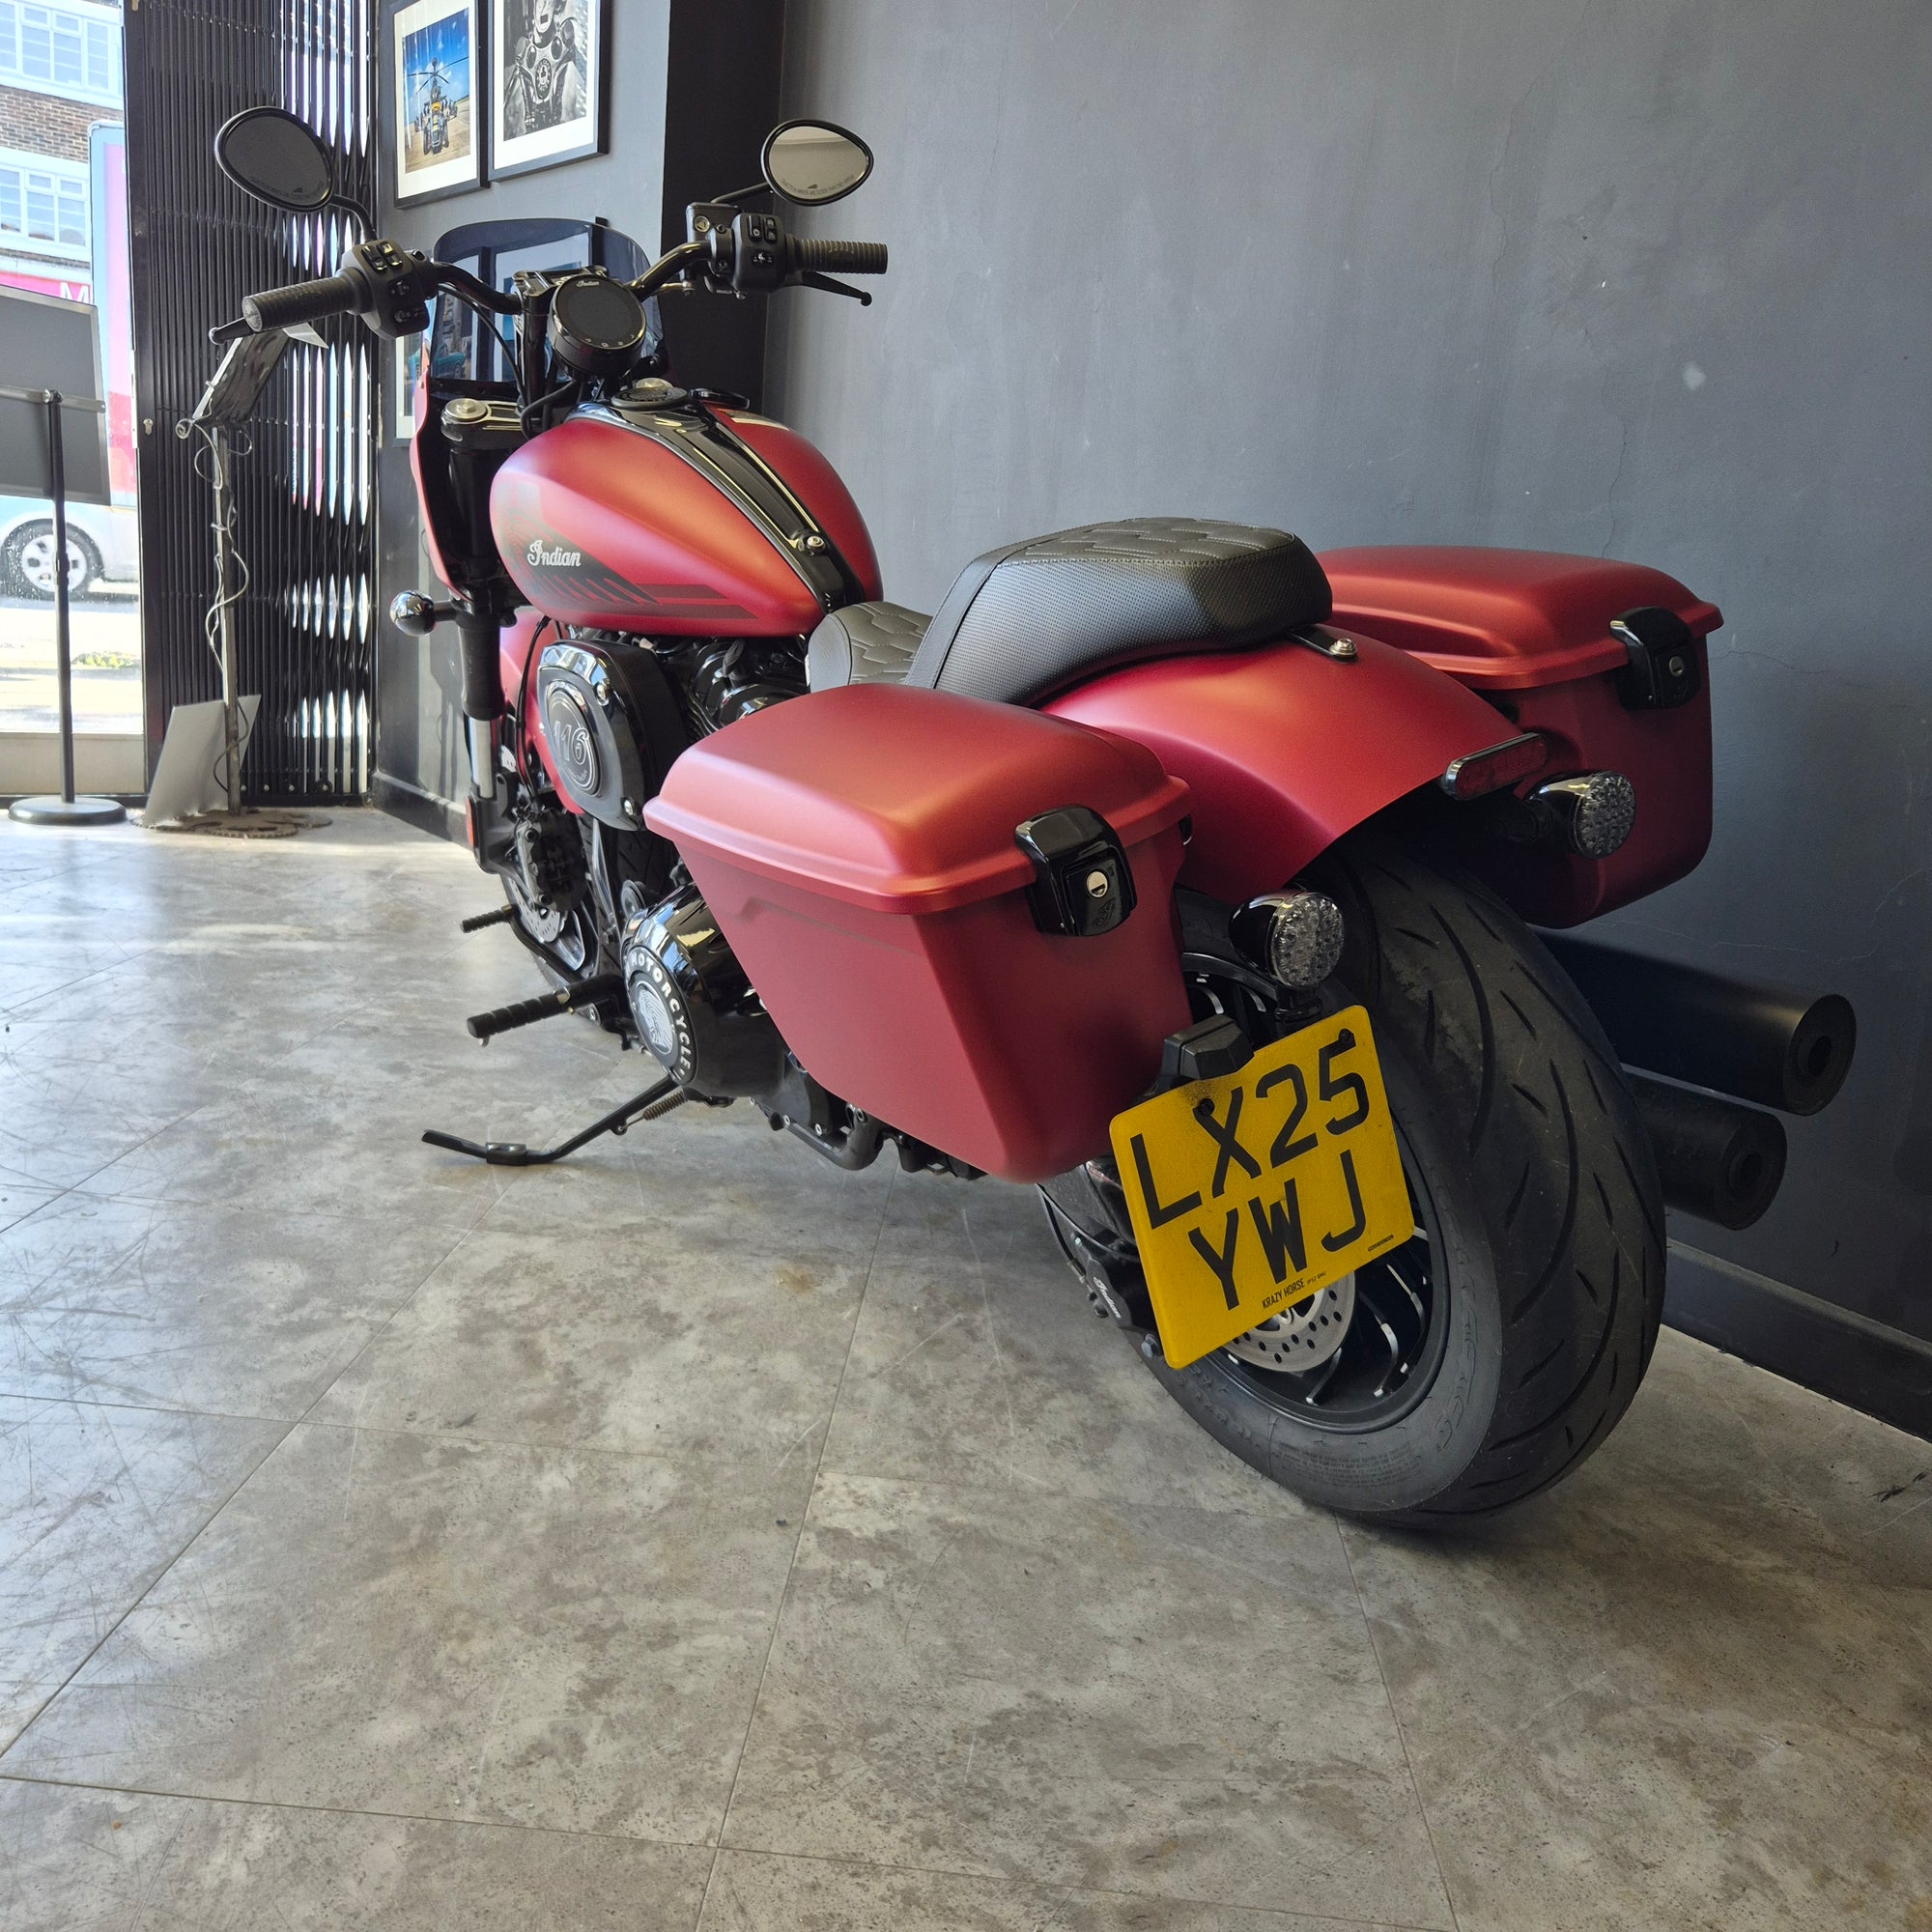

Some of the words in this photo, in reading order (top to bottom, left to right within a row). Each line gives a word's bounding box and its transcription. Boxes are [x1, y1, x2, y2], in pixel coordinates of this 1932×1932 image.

[527, 539, 582, 566] Indian
[630, 952, 693, 1069] MOTORCYCLE
[1130, 1031, 1370, 1230] LX25
[1188, 1149, 1366, 1311] YWJ
[1093, 1276, 1122, 1319] Indian
[1262, 1289, 1283, 1309] KRAZY
[1283, 1277, 1305, 1297] HORSE
